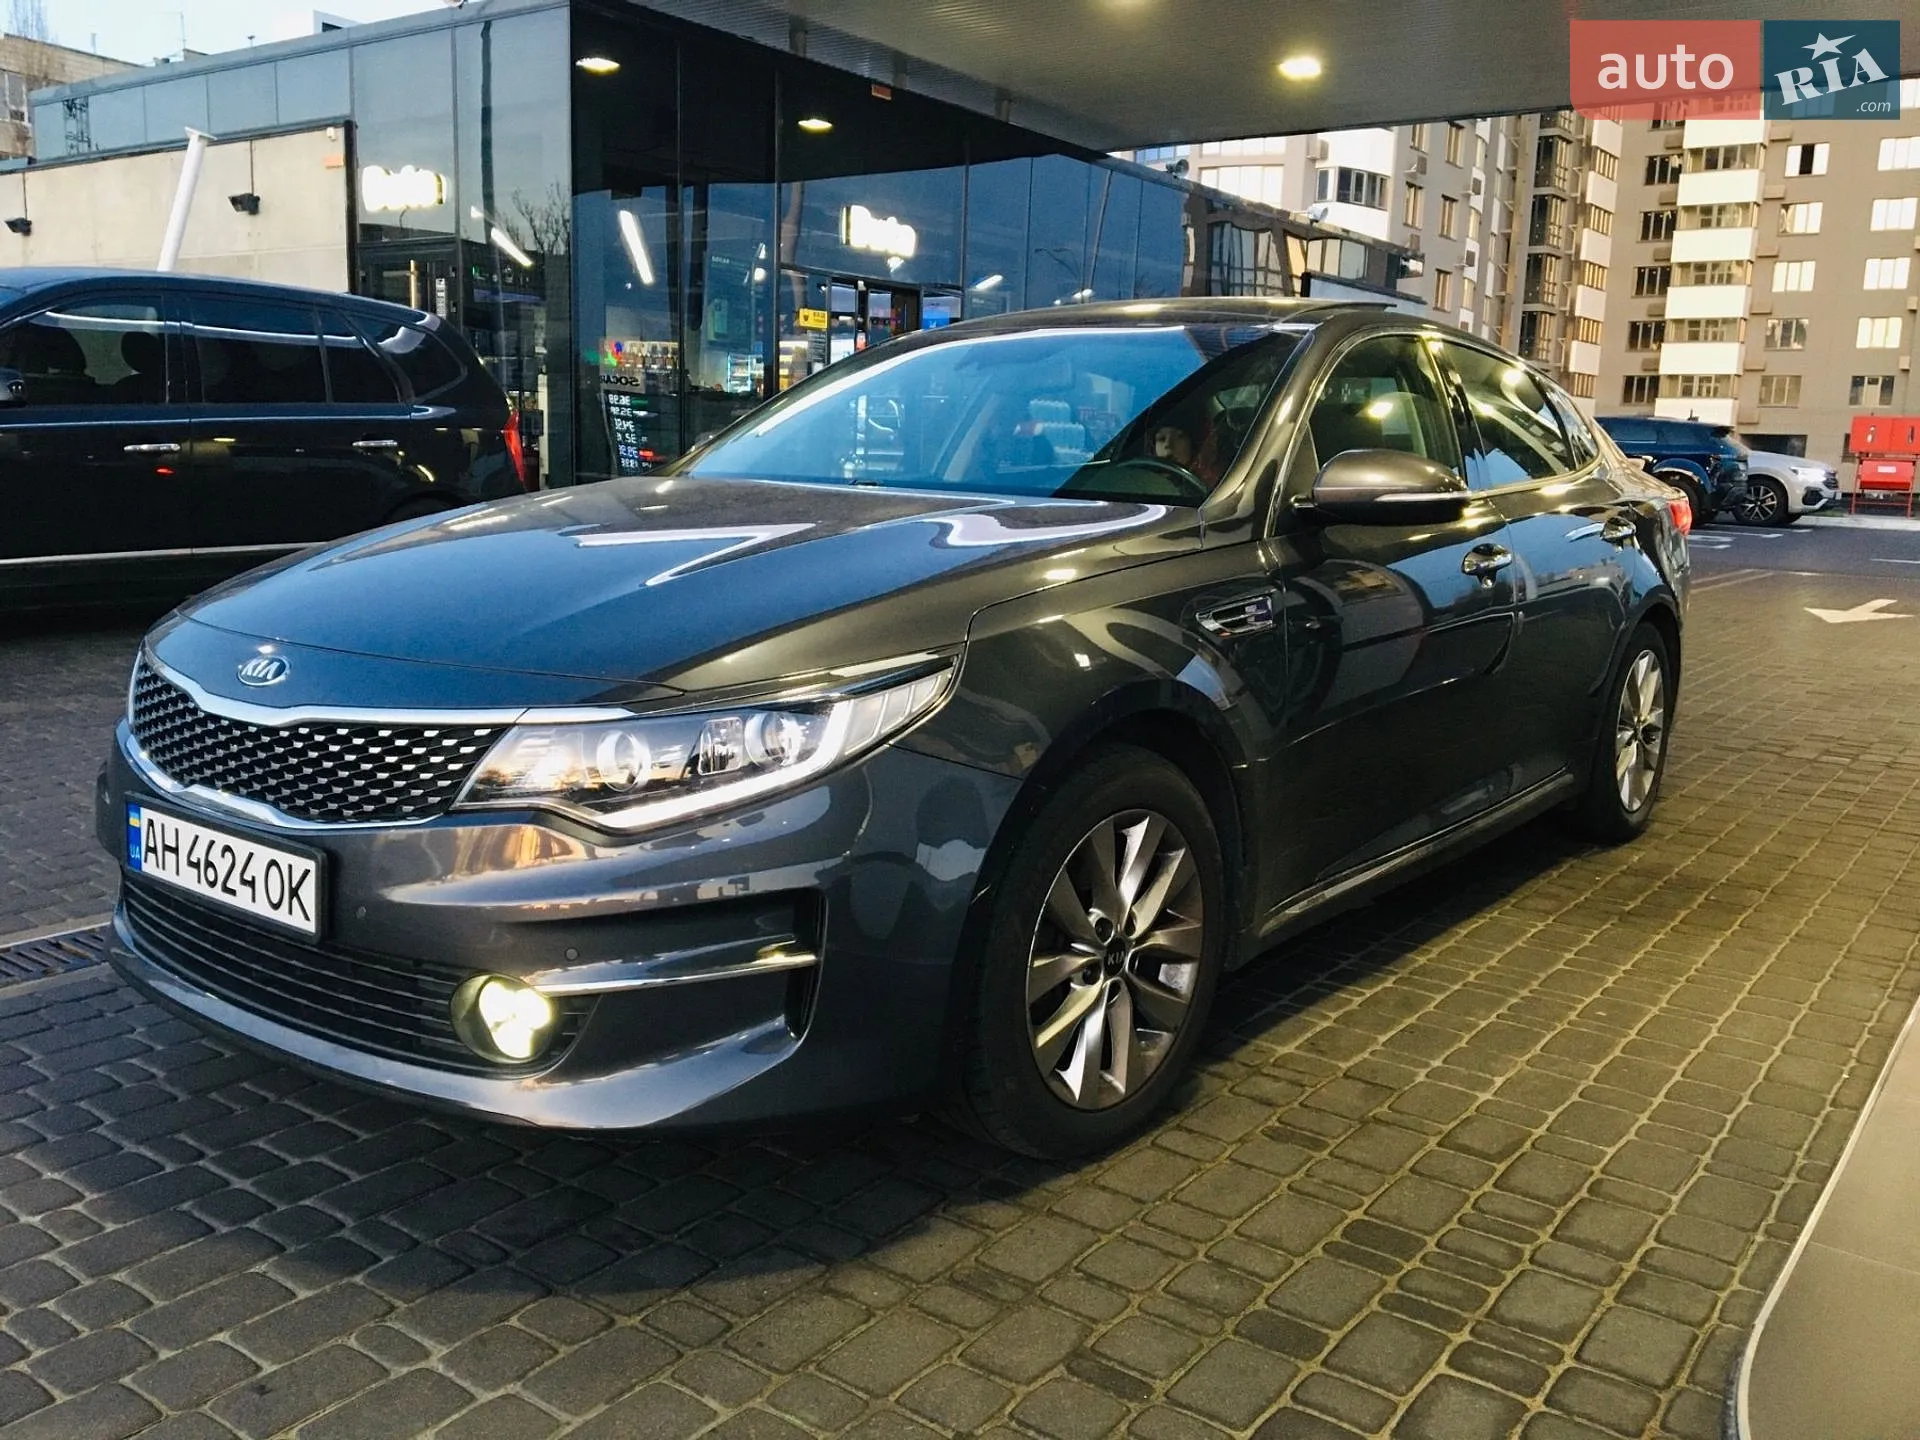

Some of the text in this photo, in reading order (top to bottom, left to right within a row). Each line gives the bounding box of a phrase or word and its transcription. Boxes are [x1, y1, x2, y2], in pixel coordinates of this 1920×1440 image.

[241, 658, 280, 680] KIA
[130, 848, 141, 859] UA
[143, 818, 312, 922] AH 4624 OK
